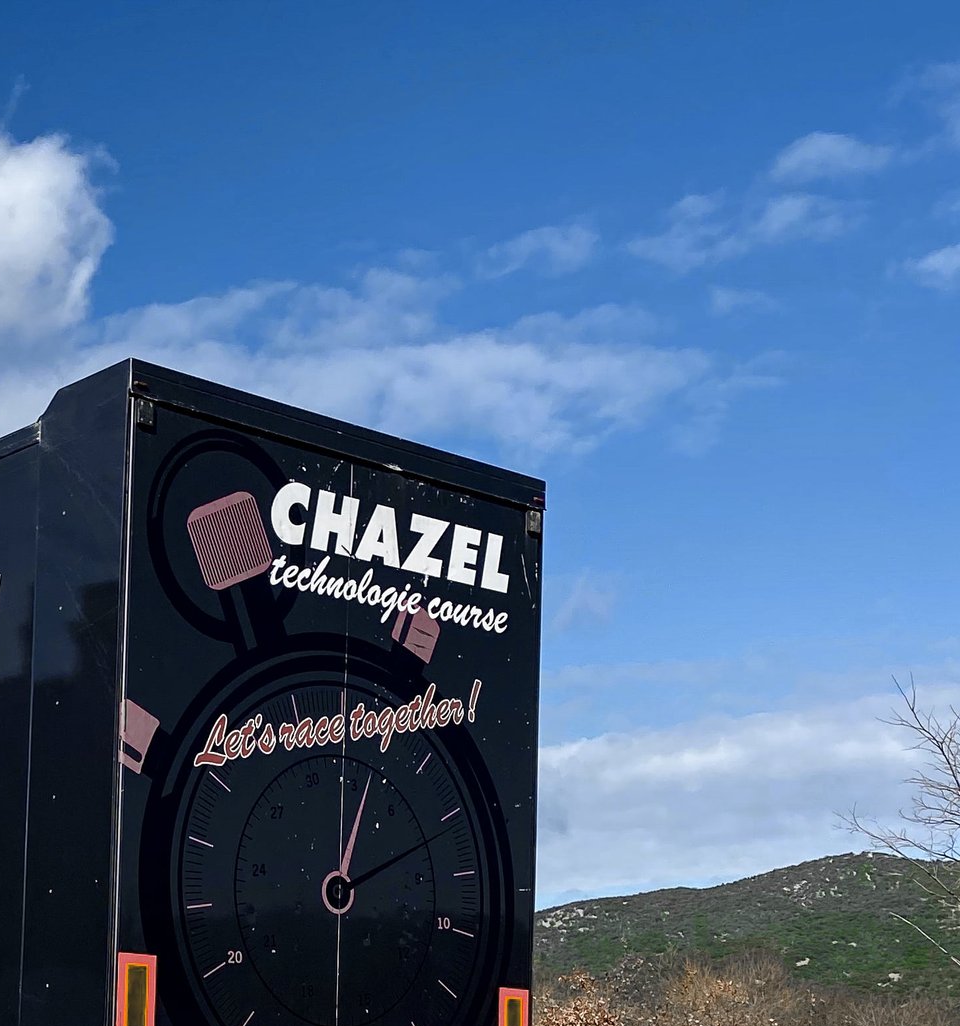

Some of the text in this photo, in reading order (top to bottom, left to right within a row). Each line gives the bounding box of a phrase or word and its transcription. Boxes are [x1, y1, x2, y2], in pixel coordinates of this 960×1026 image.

[271, 482, 510, 594] CHAZEL
[270, 555, 510, 634] technologie course
[194, 713, 275, 768] Let's
[279, 714, 345, 752] race
[306, 773, 319, 787] 30
[271, 806, 284, 819] 27
[253, 864, 266, 876] 24
[437, 918, 450, 930] 10
[227, 950, 243, 964] 20
